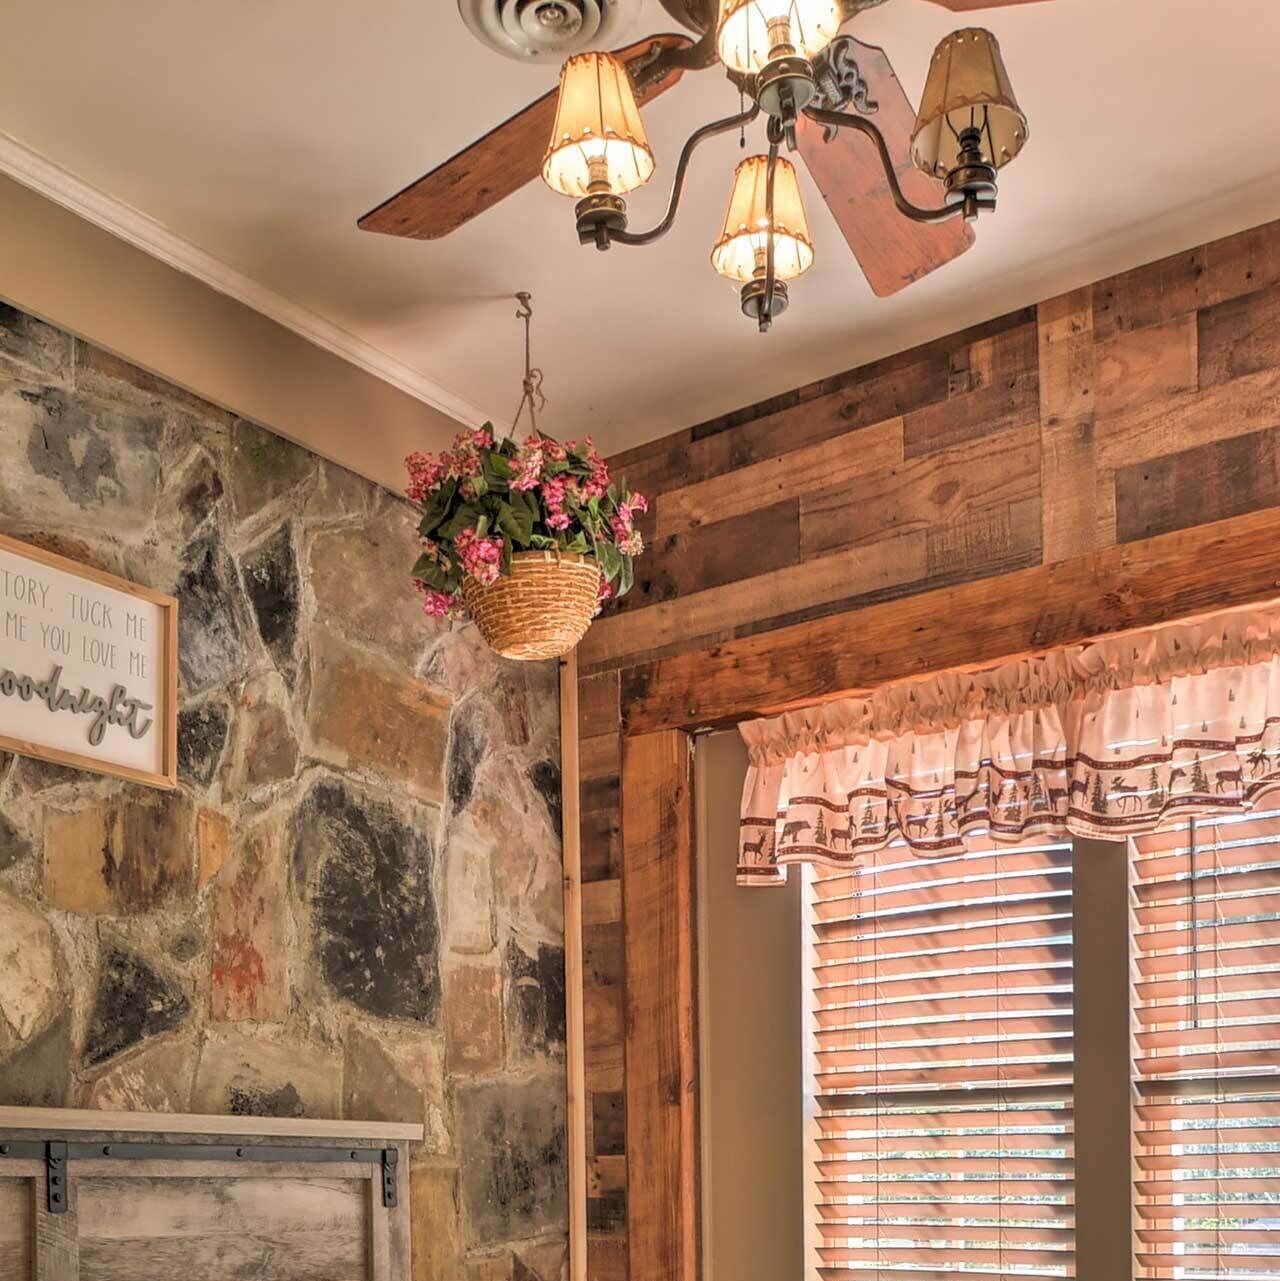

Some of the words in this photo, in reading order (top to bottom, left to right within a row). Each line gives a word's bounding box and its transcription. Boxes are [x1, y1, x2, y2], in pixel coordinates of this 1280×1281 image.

[5, 612, 28, 642] ME
[40, 622, 71, 656] YOU
[82, 635, 117, 669] LOVE
[129, 650, 148, 678] ME
[68, 592, 113, 629] TUCK
[125, 612, 147, 642] ME
